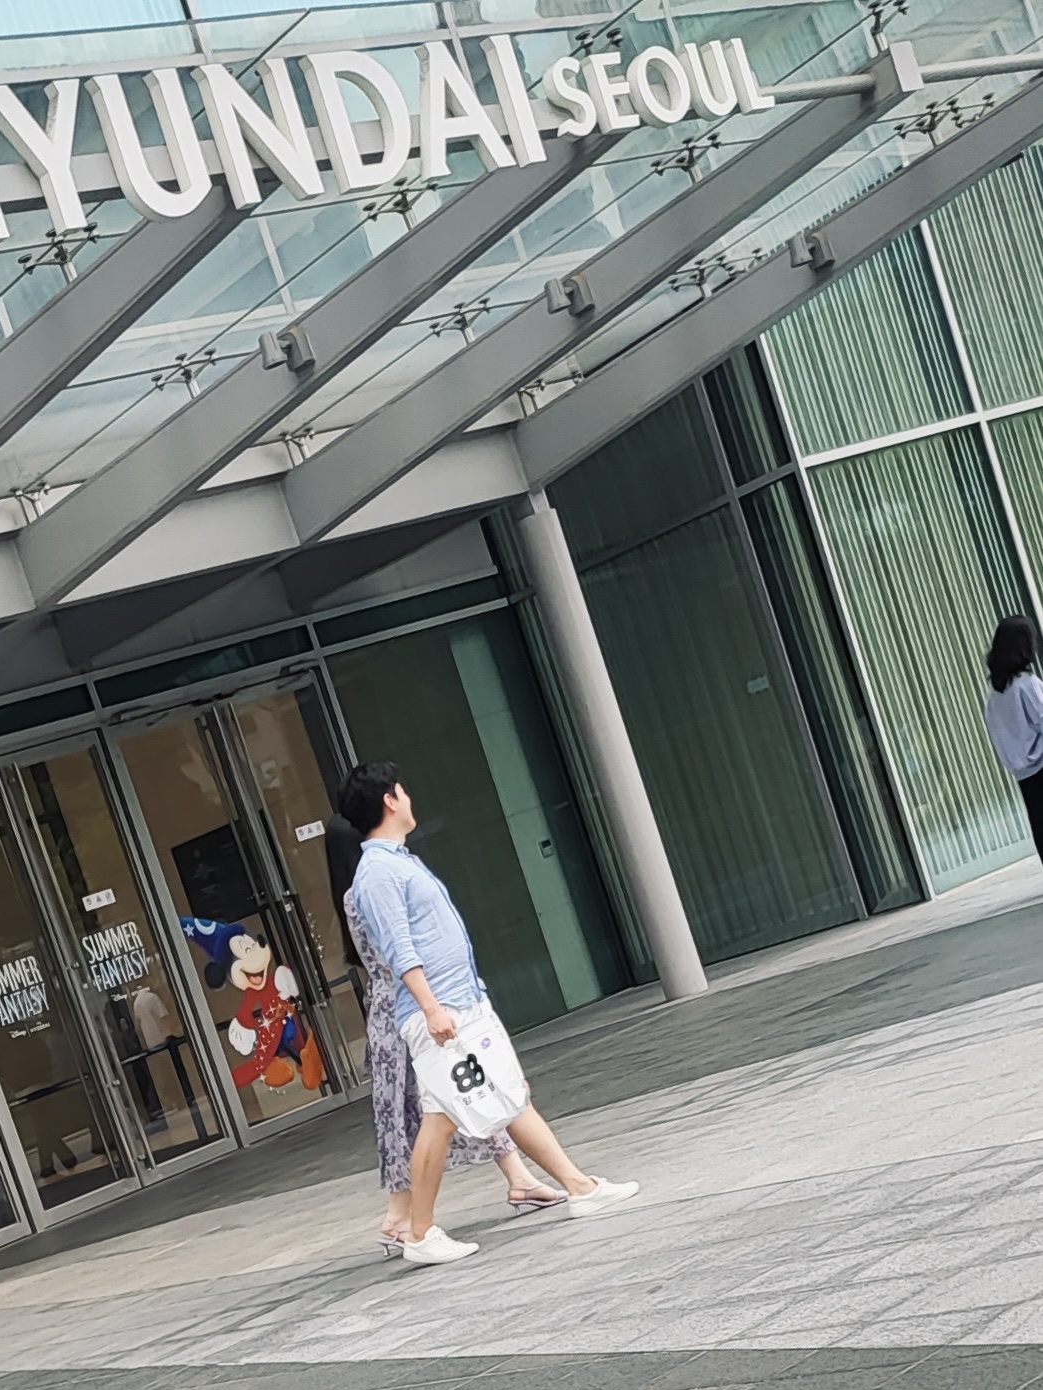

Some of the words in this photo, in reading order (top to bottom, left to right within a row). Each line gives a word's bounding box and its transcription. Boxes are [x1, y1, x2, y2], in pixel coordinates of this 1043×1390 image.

[542, 37, 775, 138] SEOUL
[82, 921, 144, 964] SUMMER
[90, 948, 149, 992] FANTASY
